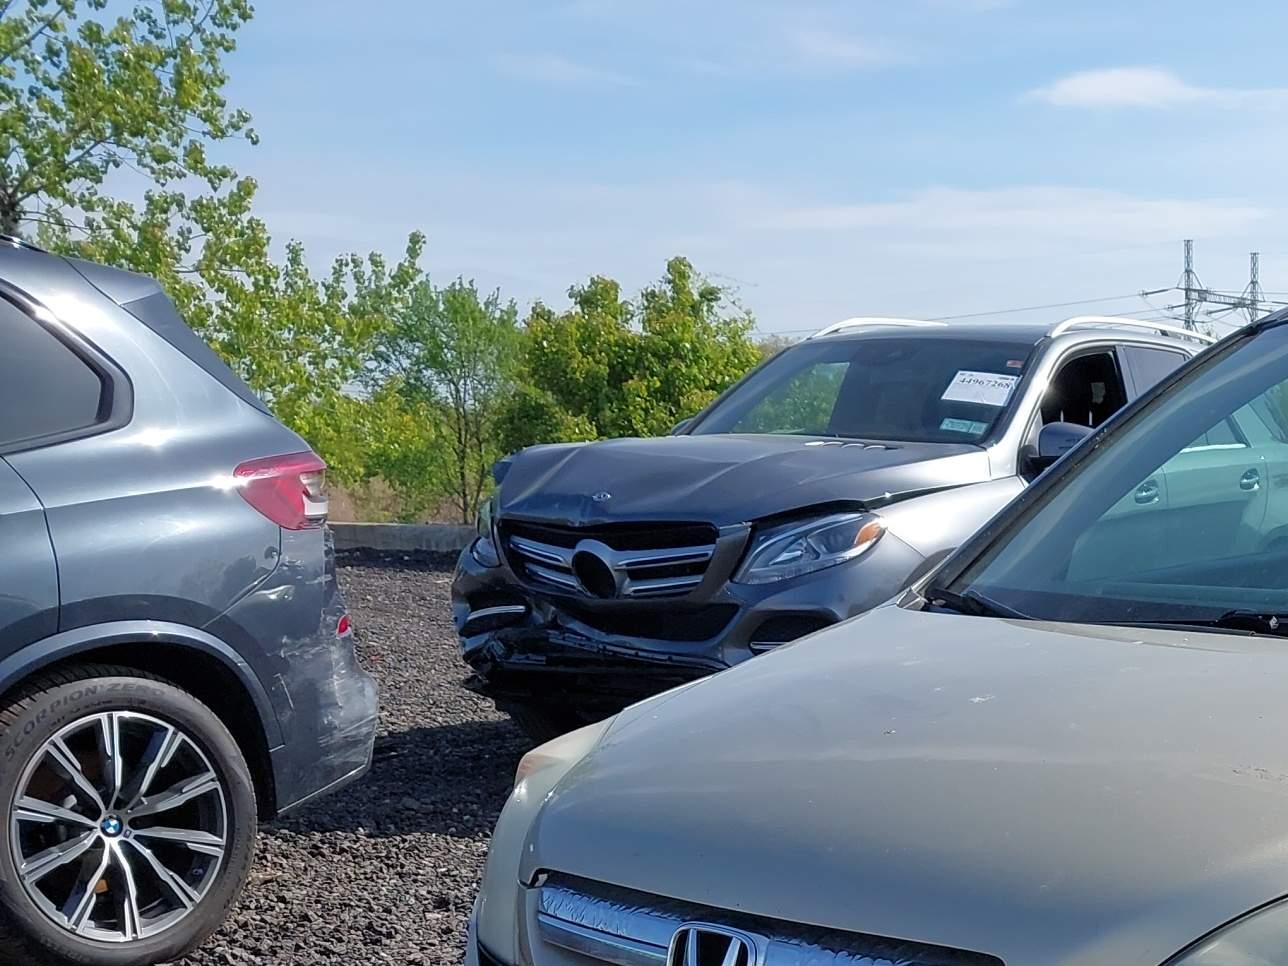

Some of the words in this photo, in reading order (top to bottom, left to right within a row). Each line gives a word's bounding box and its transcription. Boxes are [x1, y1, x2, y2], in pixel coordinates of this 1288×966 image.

[958, 377, 1010, 389] 44967268
[4, 684, 98, 762] SCORPION
[106, 682, 167, 697] ZERO
